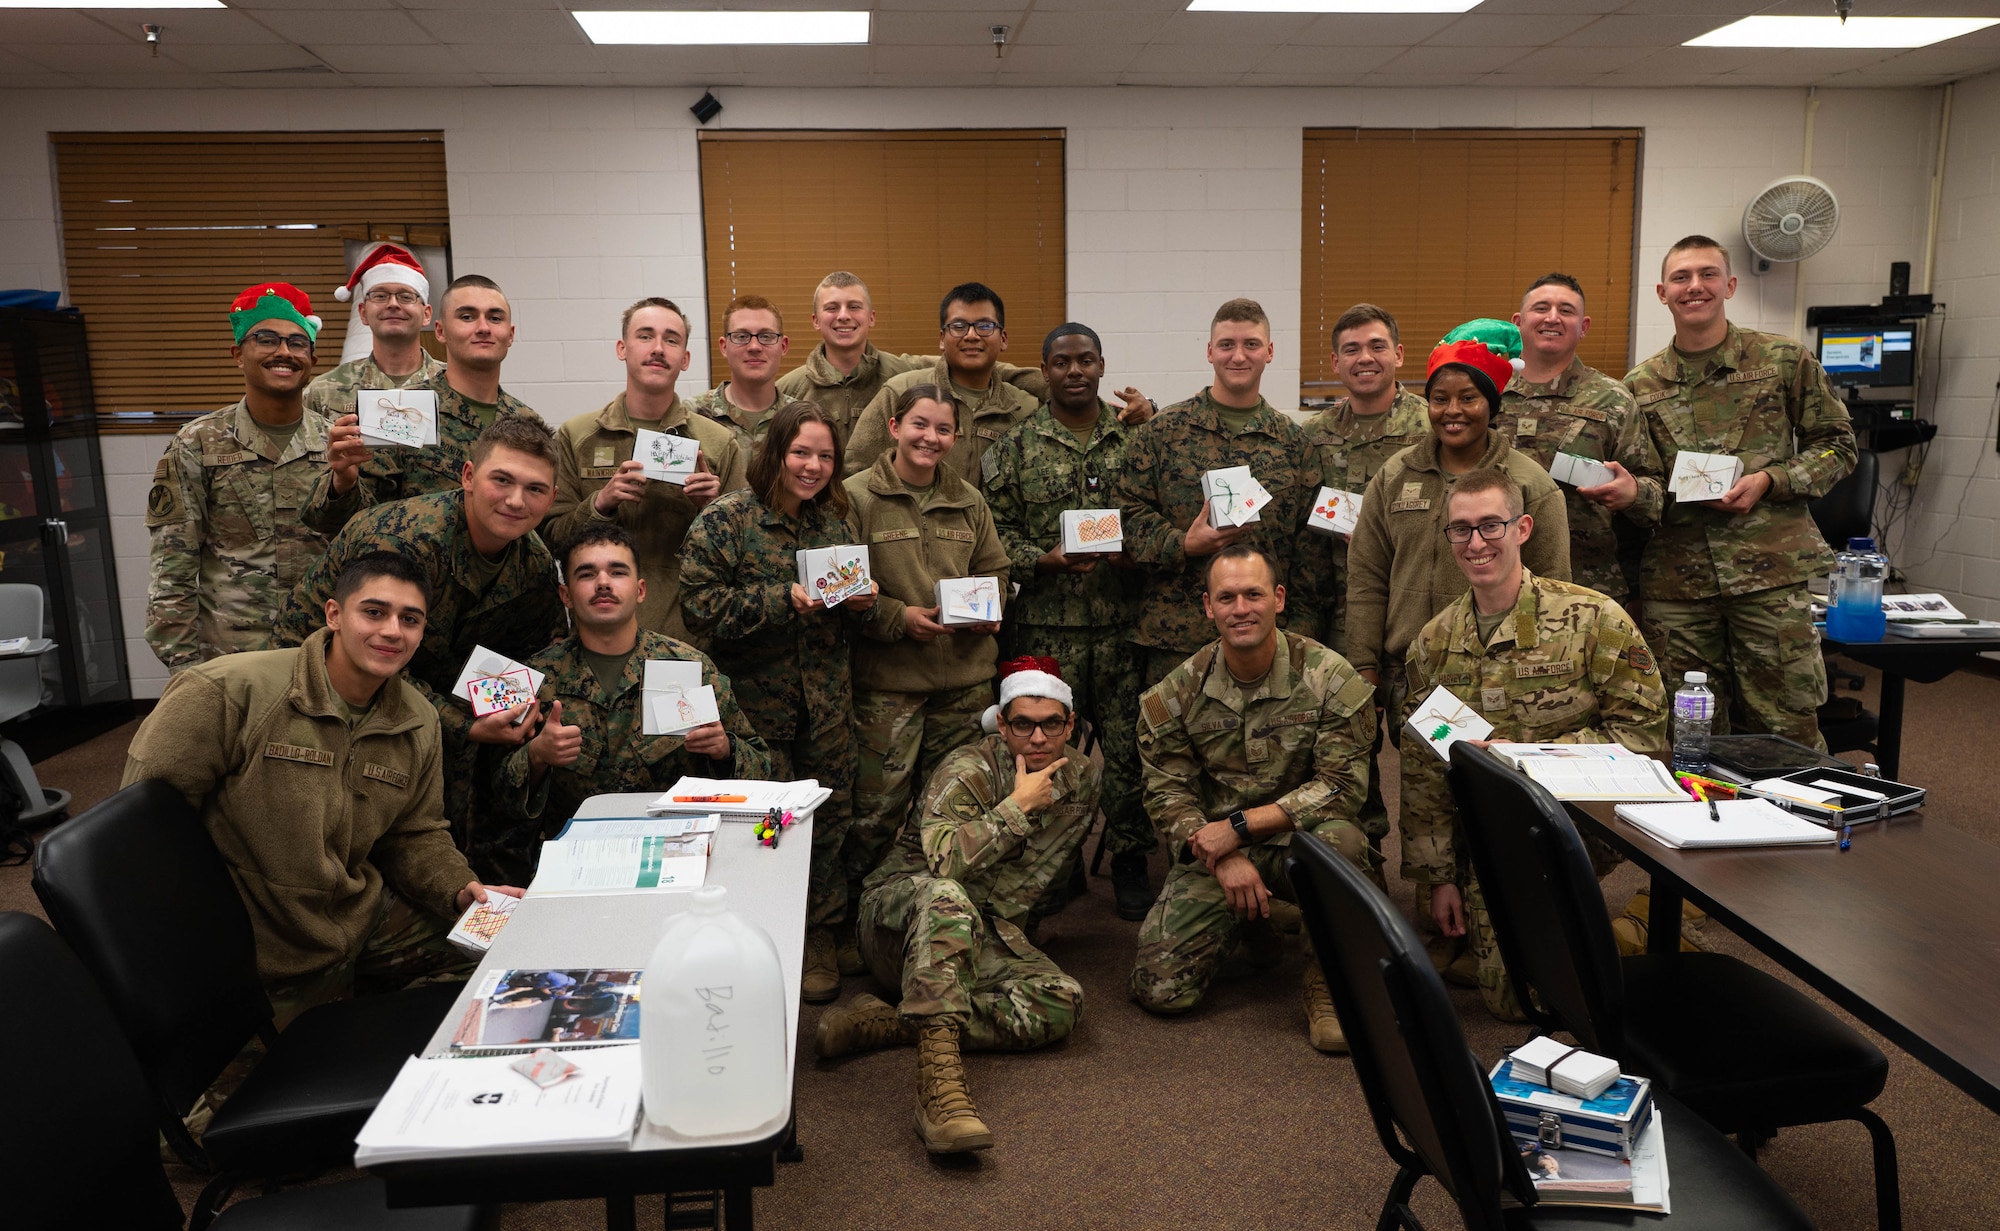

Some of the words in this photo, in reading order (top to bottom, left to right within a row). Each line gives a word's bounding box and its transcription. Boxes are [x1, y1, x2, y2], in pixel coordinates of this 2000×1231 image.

[1743, 371, 1753, 380] AIR
[1754, 367, 1776, 379] FORCE
[1650, 390, 1667, 400] COOK
[1585, 410, 1605, 420] FORCE
[217, 452, 244, 464] REIDER
[1037, 467, 1050, 476] LEE
[882, 530, 909, 540] GREENE
[956, 531, 973, 540] FORCE
[1532, 665, 1546, 675] AIR
[1546, 663, 1571, 674] FORCE
[1438, 674, 1461, 684] HARVEY
[1294, 712, 1315, 723] FORCE
[1201, 721, 1222, 731] SILVA
[268, 744, 332, 764] BADILLO-ROLDAN
[381, 769, 392, 780] AIR
[661, 875, 675, 884] 18
